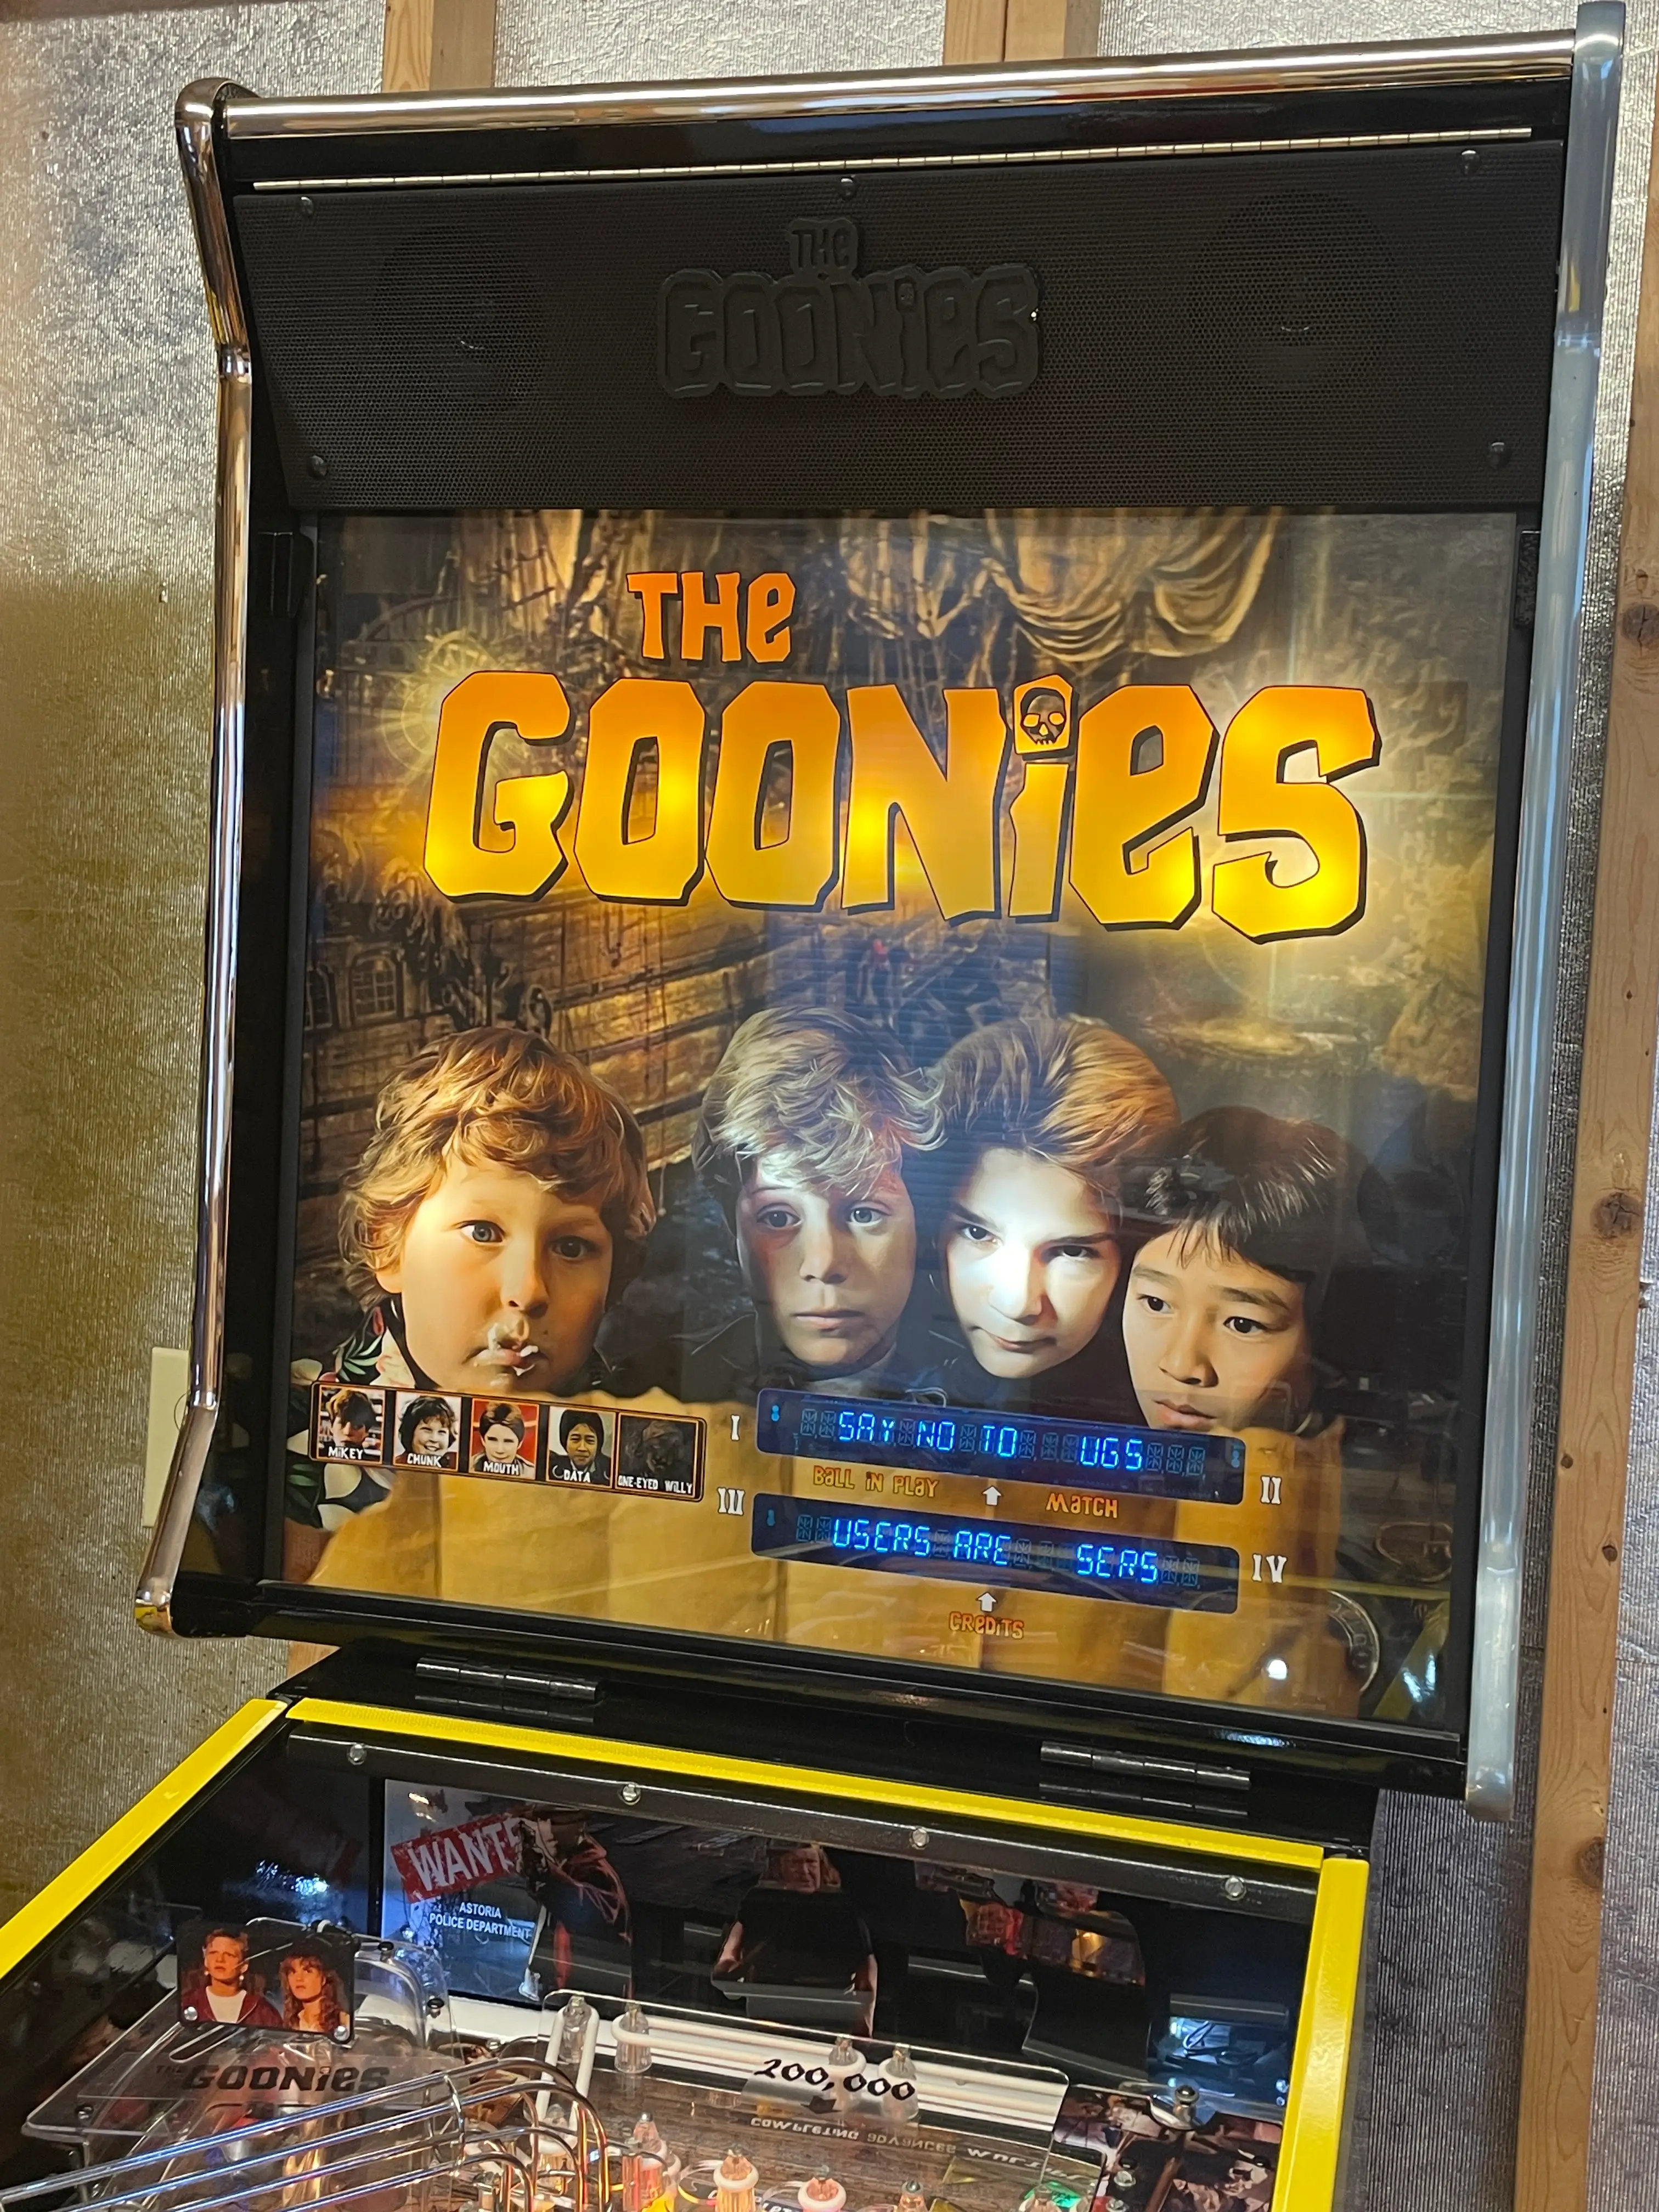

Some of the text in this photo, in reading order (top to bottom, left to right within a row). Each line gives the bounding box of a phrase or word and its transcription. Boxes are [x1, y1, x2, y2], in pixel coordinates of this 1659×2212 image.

[838, 1410, 1143, 1471] SAY NO TO UGS
[407, 1453, 442, 1468] CHUNK
[483, 1460, 521, 1476] MOUTH
[563, 1469, 591, 1483] DATA
[618, 1475, 658, 1490] ONE-EYED
[1260, 1475, 1282, 1505] II
[716, 1486, 746, 1516] III
[832, 1517, 1159, 1583] USERS ARE SERS
[1252, 1553, 1288, 1584] IV
[459, 1901, 502, 1920] ASTORIA
[429, 1912, 532, 1939] POLICE DEPARTMENT
[753, 2058, 916, 2102] 200,000
